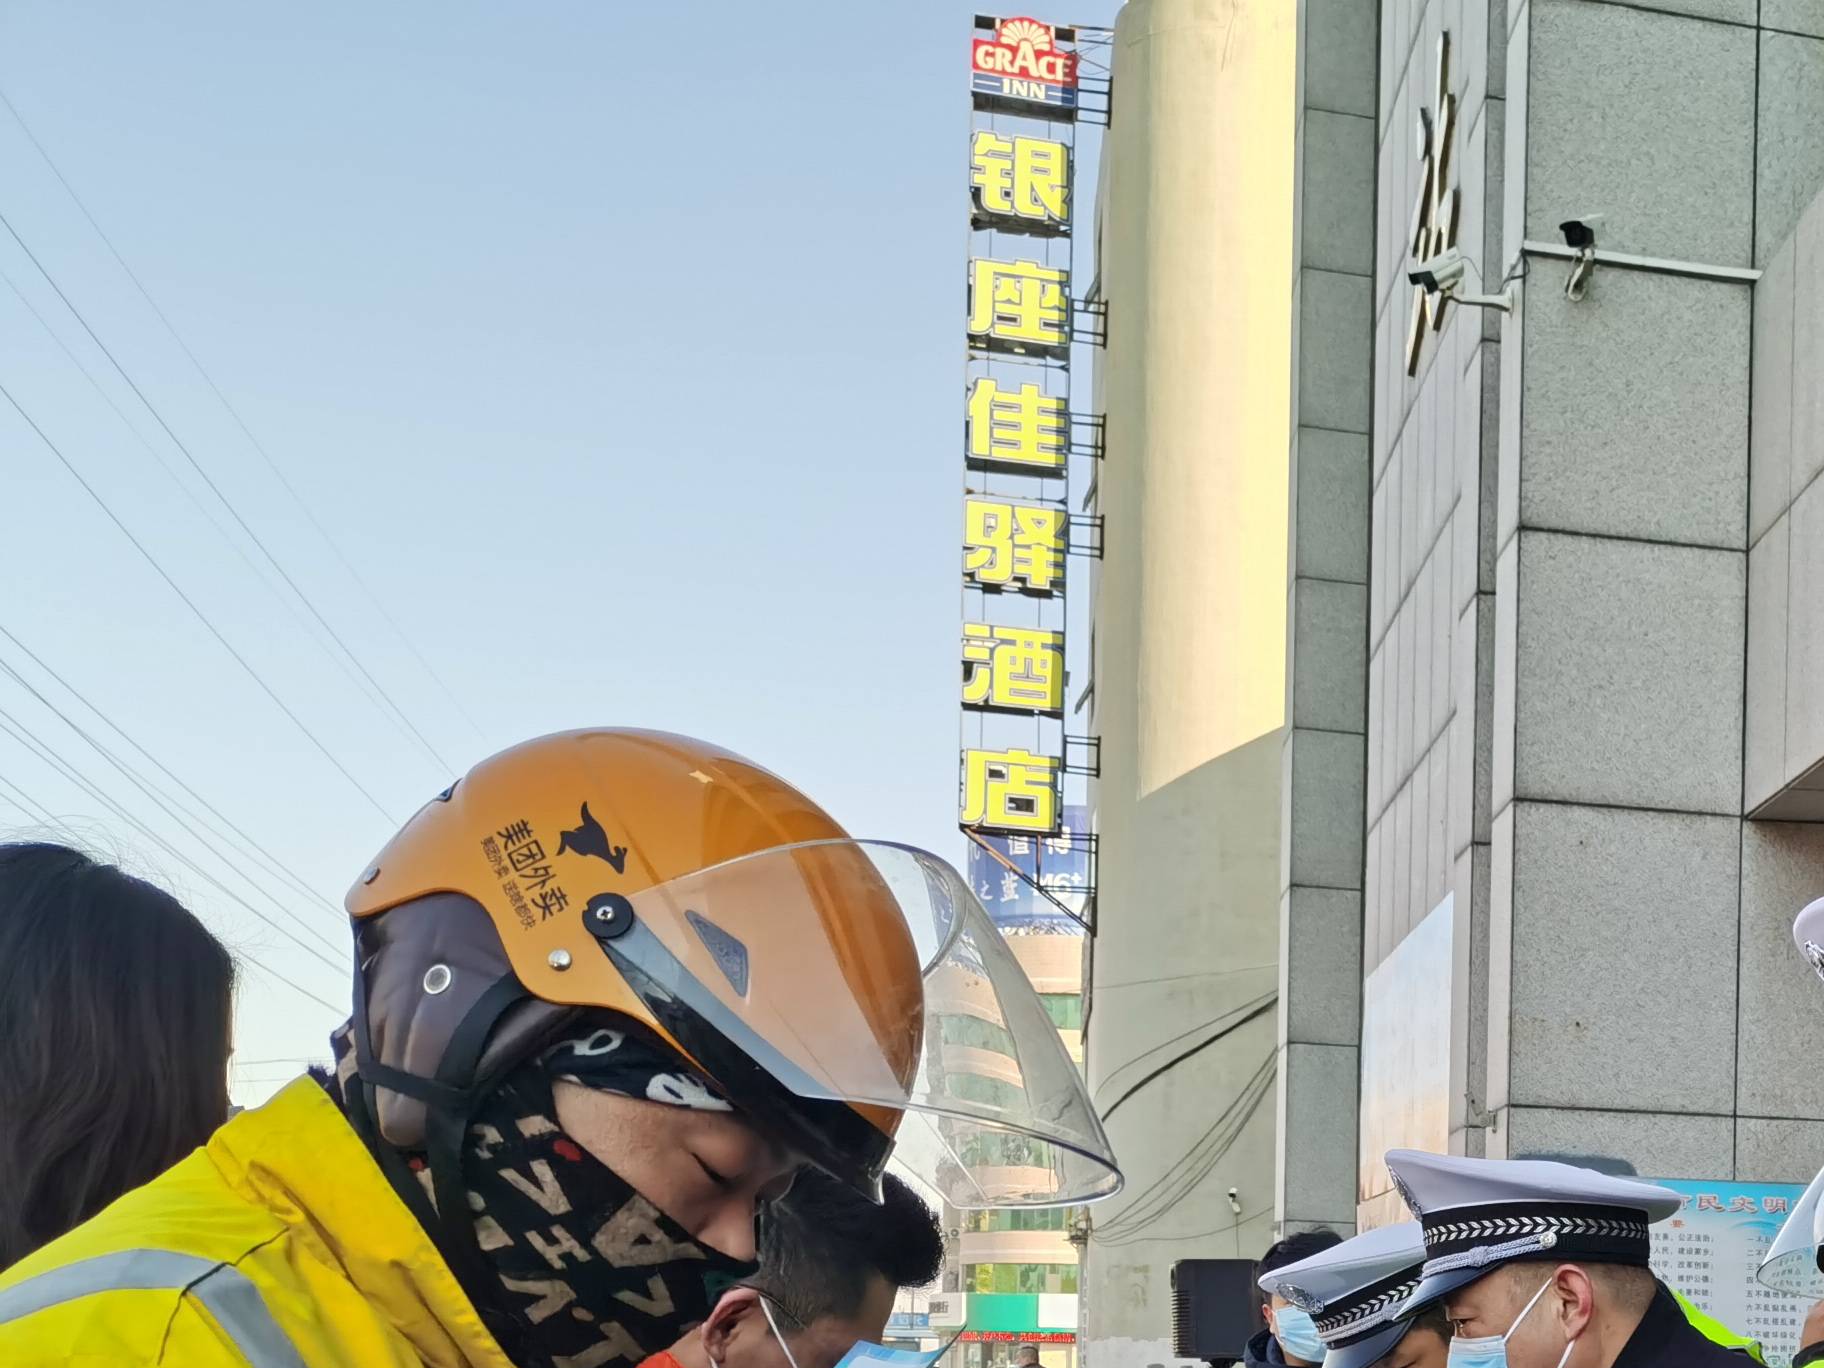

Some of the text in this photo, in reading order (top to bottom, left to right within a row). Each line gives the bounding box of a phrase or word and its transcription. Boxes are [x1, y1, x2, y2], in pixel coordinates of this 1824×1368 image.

[976, 42, 1073, 81] GRACE
[1003, 79, 1046, 100] INN
[963, 131, 1070, 831] 银座佳驿酒店
[497, 819, 569, 921] 美团外卖
